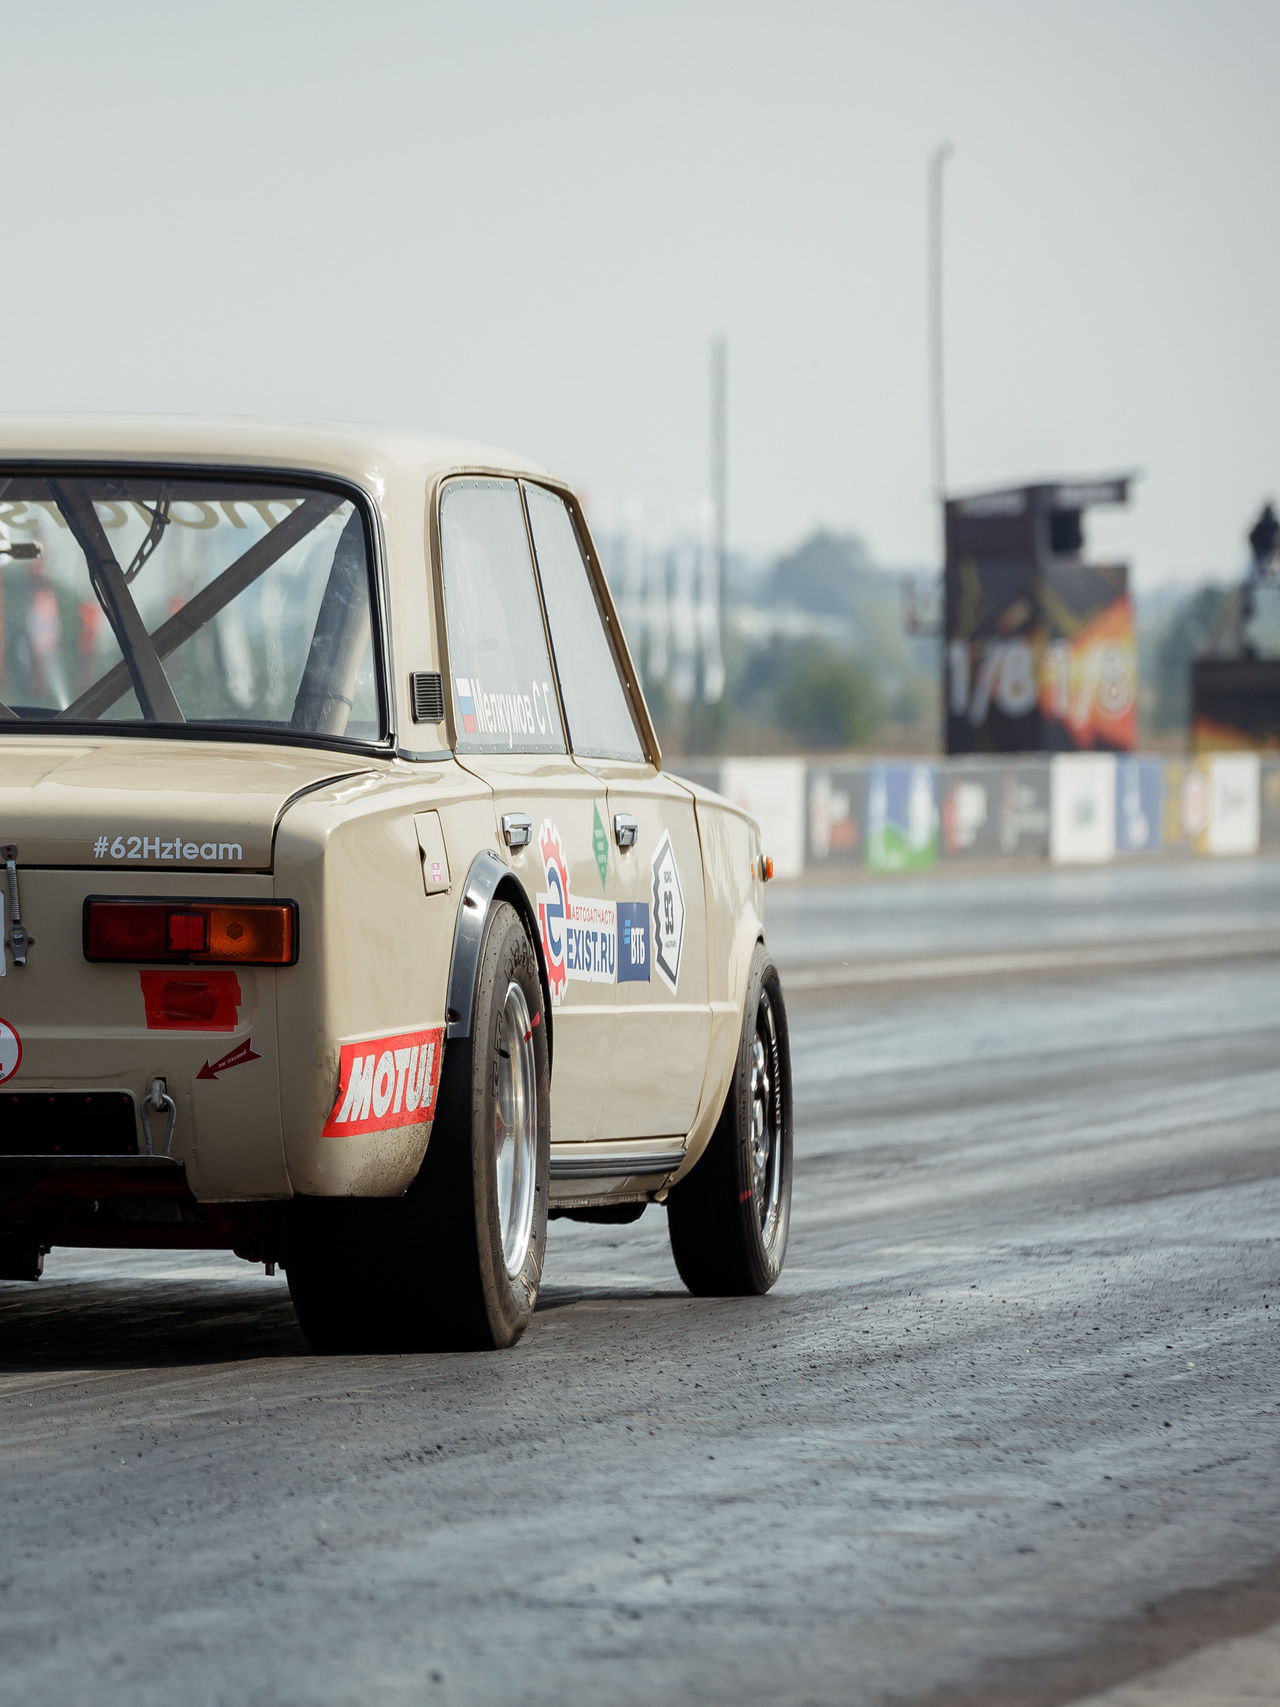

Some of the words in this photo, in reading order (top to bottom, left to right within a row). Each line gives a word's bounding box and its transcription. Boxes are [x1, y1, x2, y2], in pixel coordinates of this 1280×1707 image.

[470, 678, 535, 749] Мелкумов
[93, 836, 243, 860] #62Hzteam
[571, 906, 616, 926] АВТОЗАПЧАСТИ
[566, 928, 616, 975] EXIST.RU
[630, 927, 646, 965] ВТБ
[334, 1042, 436, 1123] MOTUL
